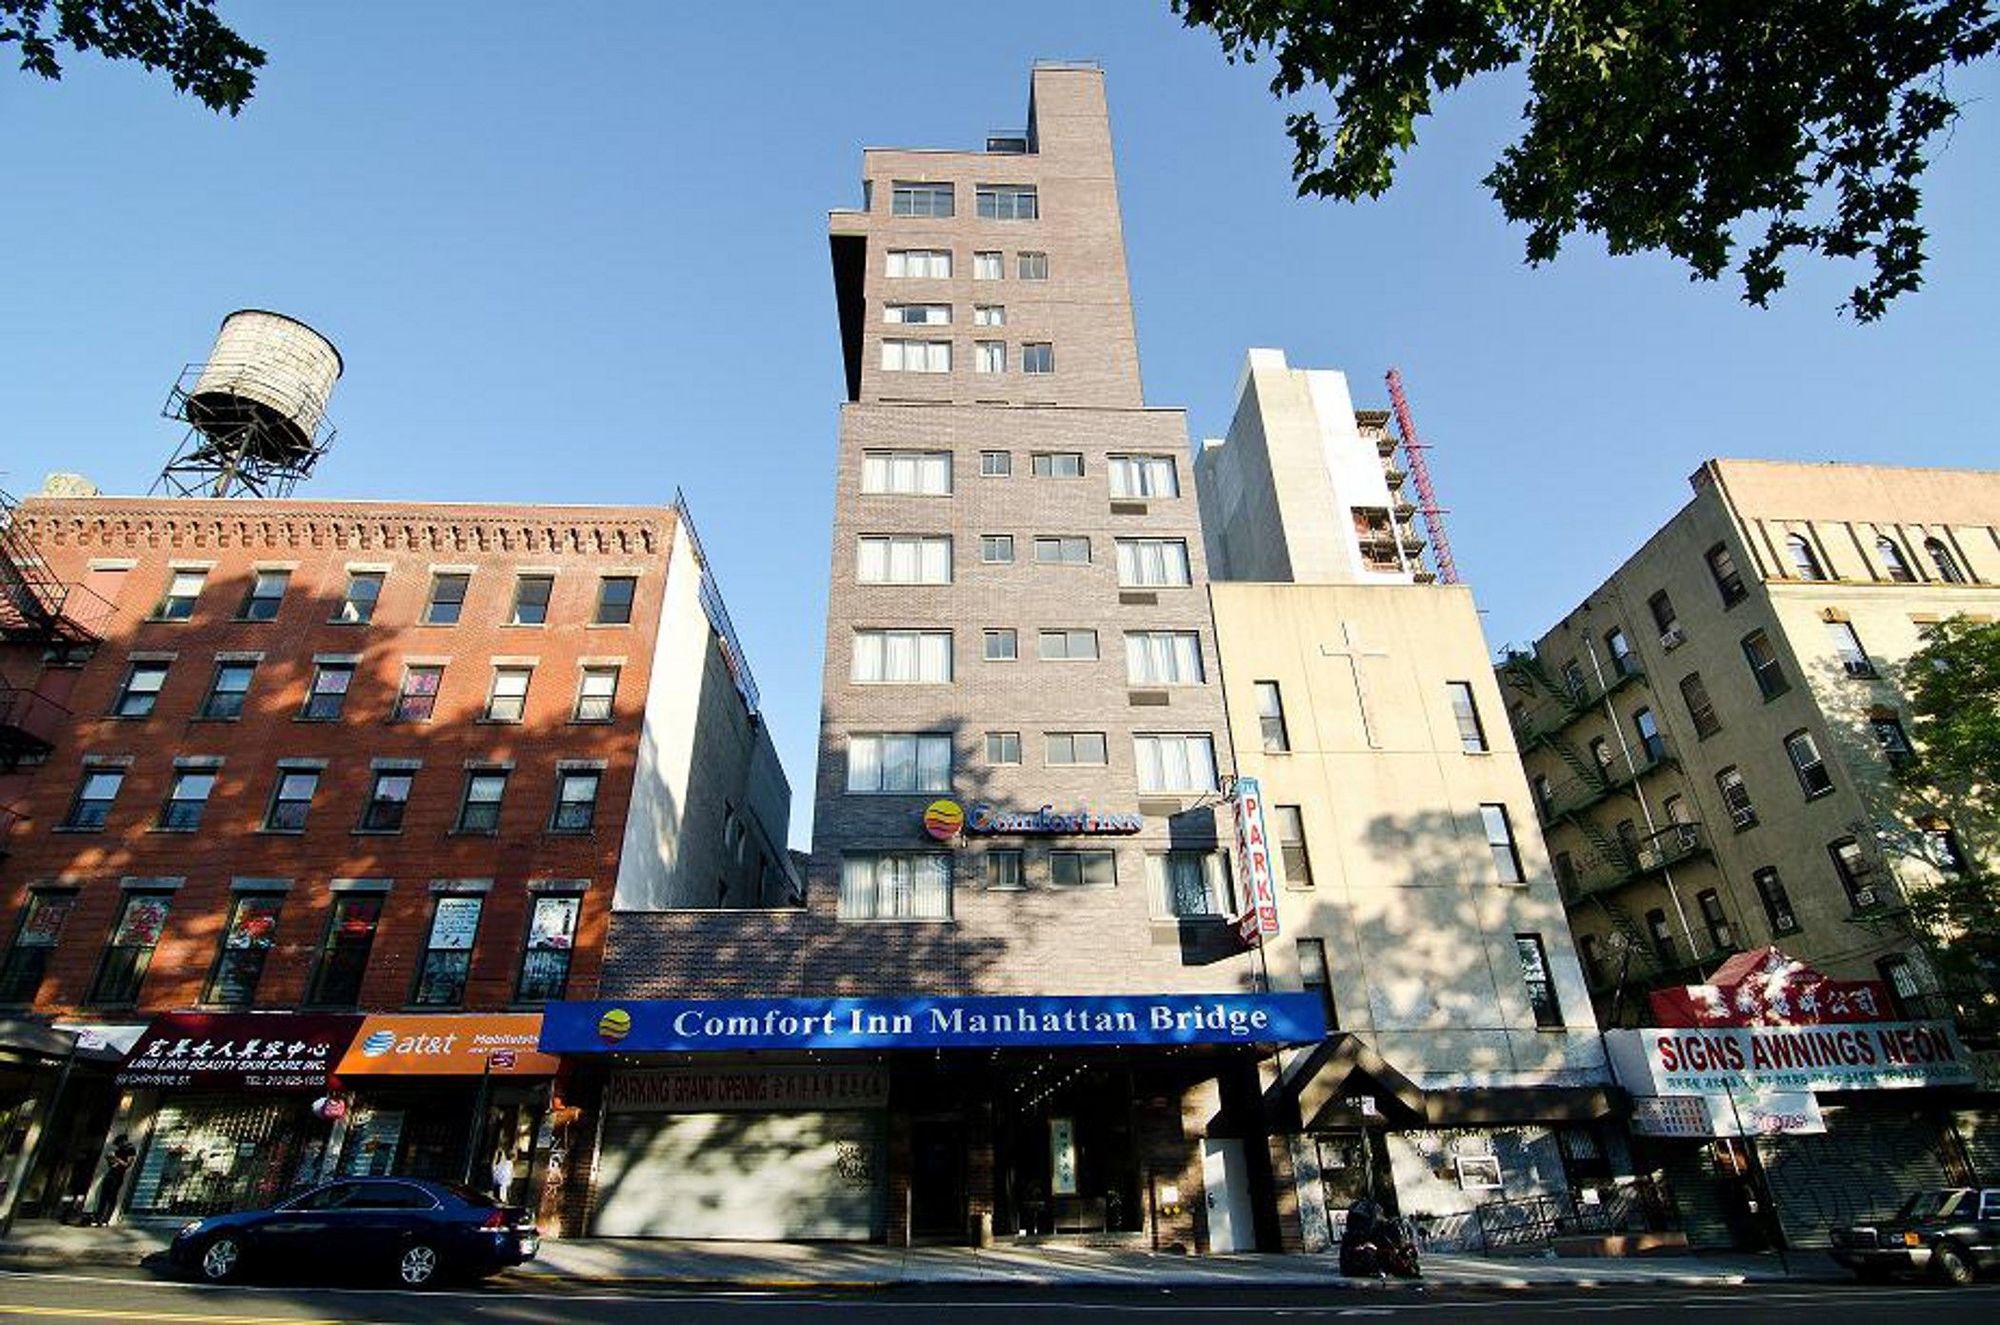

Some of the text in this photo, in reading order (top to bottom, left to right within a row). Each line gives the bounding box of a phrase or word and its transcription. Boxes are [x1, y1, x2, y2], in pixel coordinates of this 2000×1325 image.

[967, 803, 1090, 832] Comfort
[1246, 798, 1271, 901] PARK
[673, 1004, 1268, 1037] Comfort Inn Manhattan Bridge
[395, 1032, 458, 1055] at&t
[1657, 1026, 1956, 1073] SIGNS AWNINGS NEON
[188, 1058, 238, 1070] BEAUTY
[238, 1059, 265, 1070] SKIN
[268, 1059, 301, 1071] CARE
[612, 1074, 669, 1104] PARKING
